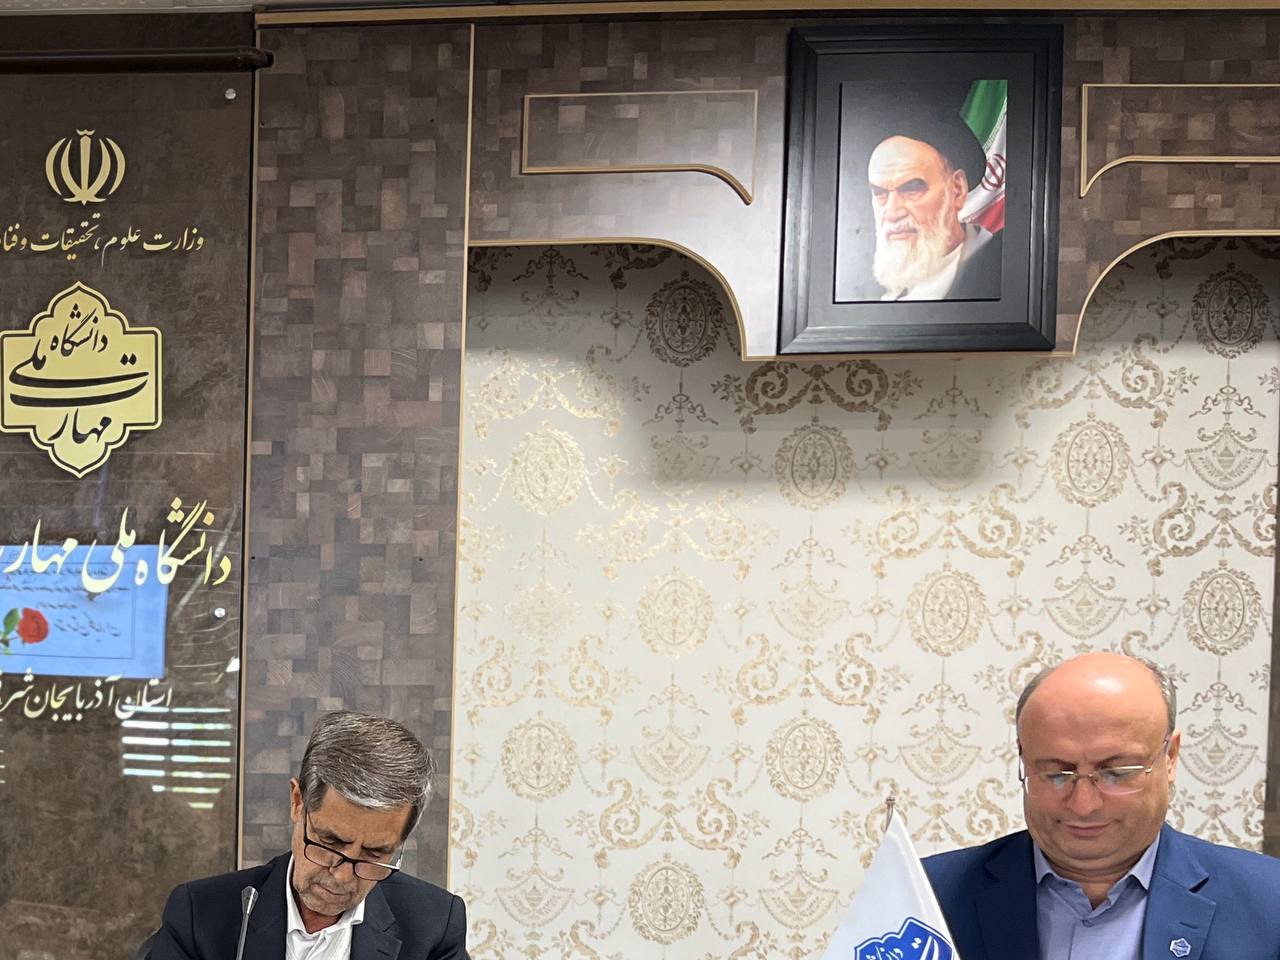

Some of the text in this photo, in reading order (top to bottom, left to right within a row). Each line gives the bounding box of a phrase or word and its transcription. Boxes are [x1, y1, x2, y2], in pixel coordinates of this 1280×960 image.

[30, 212, 101, 260] تحقیقات
[143, 224, 204, 251] وزارت
[50, 303, 109, 358] دانشگاه
[81, 506, 137, 594] ملی
[134, 496, 232, 586] دانشگاه
[23, 674, 122, 722] آذربایجان
[115, 678, 172, 720] استان
